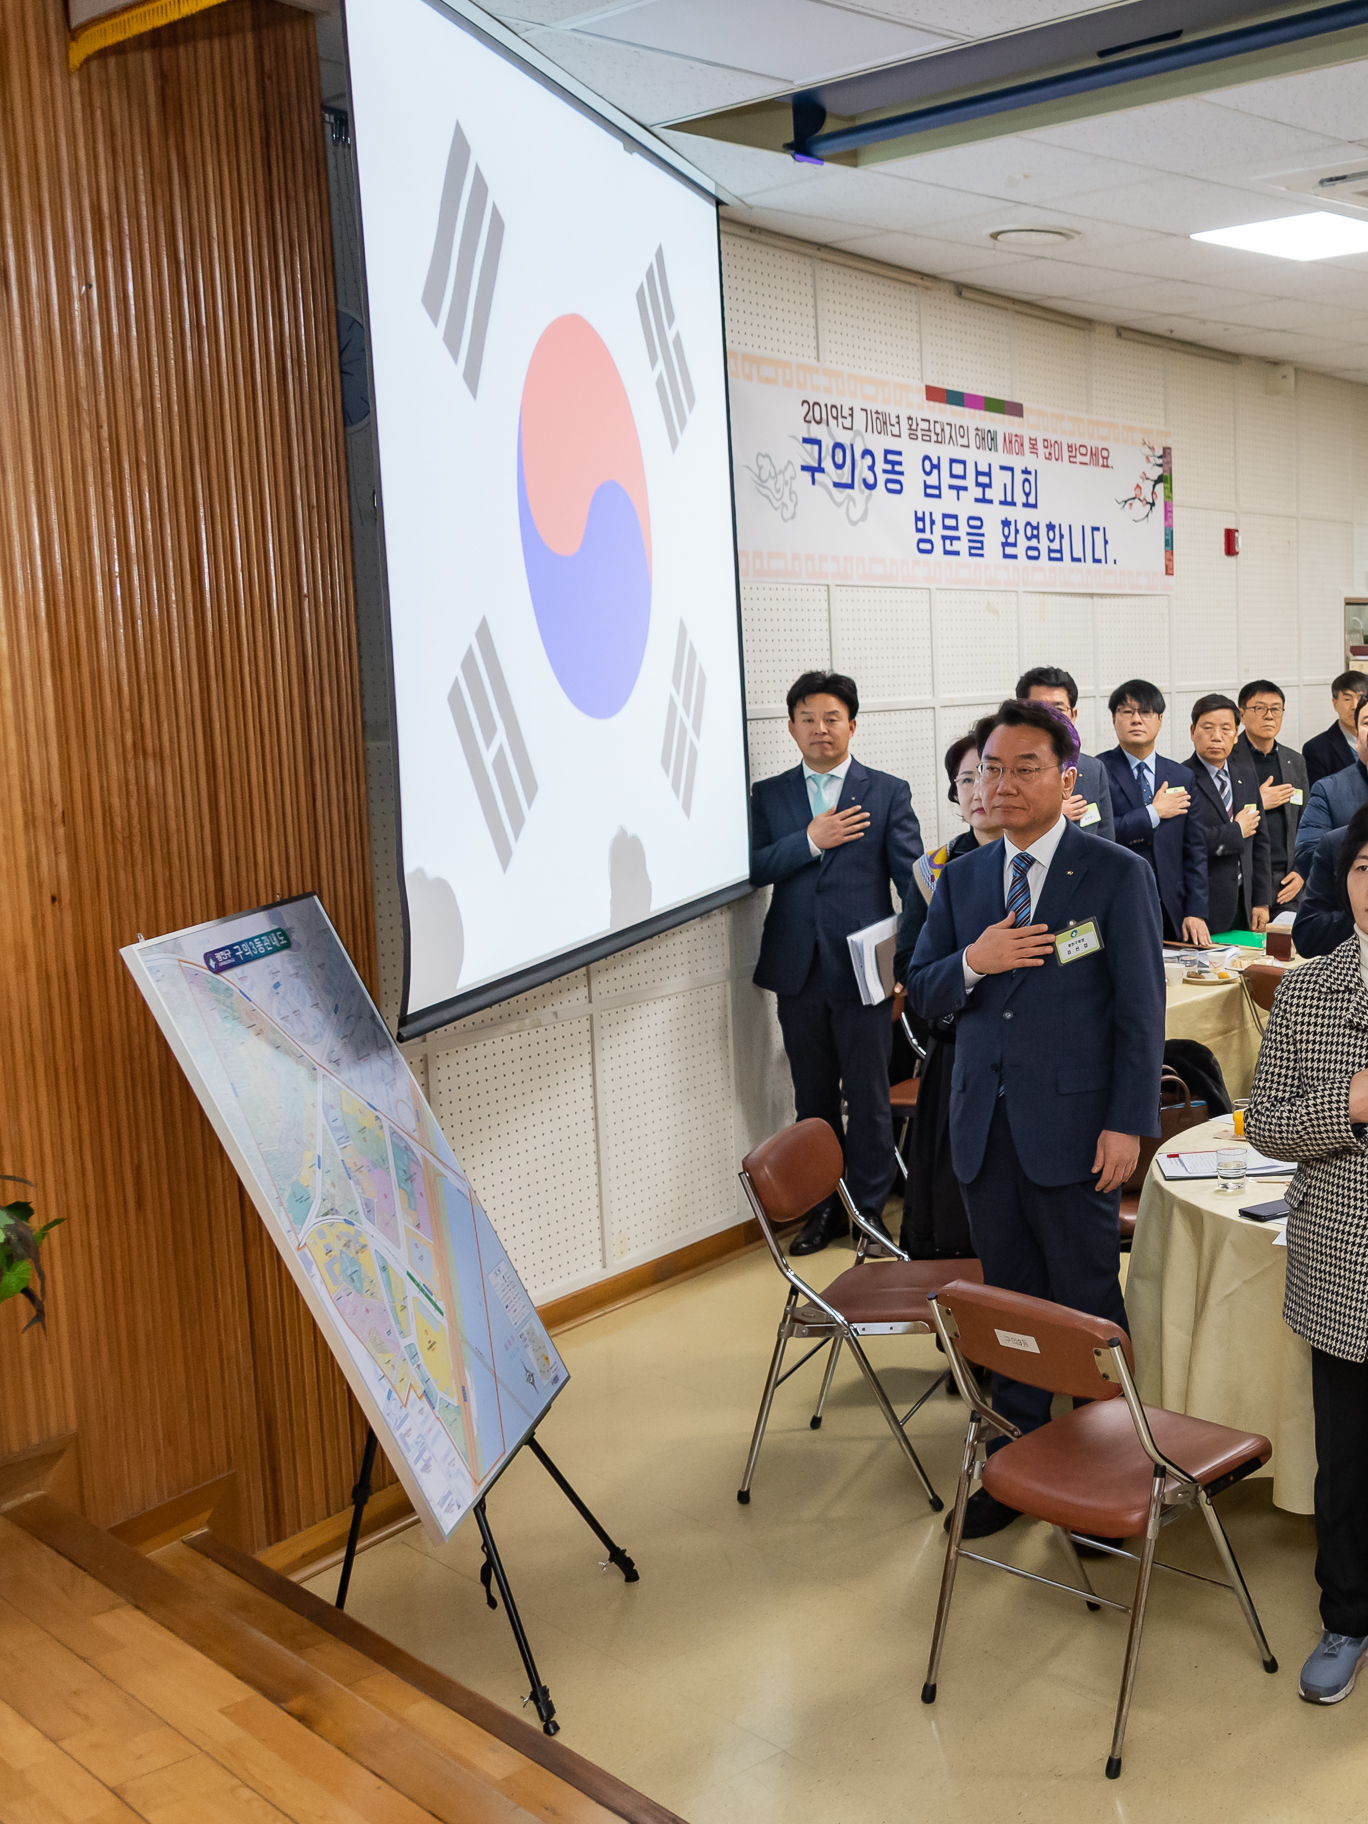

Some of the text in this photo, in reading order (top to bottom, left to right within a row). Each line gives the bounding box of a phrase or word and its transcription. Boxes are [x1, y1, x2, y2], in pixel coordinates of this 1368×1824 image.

[801, 399, 1114, 469] 2019년 기해년 황금돼지의 해에 새해 복 많이 받으세요.
[800, 437, 1038, 509] 구의3동 업무보고회
[914, 510, 1117, 565] 방문을 환영합니다.
